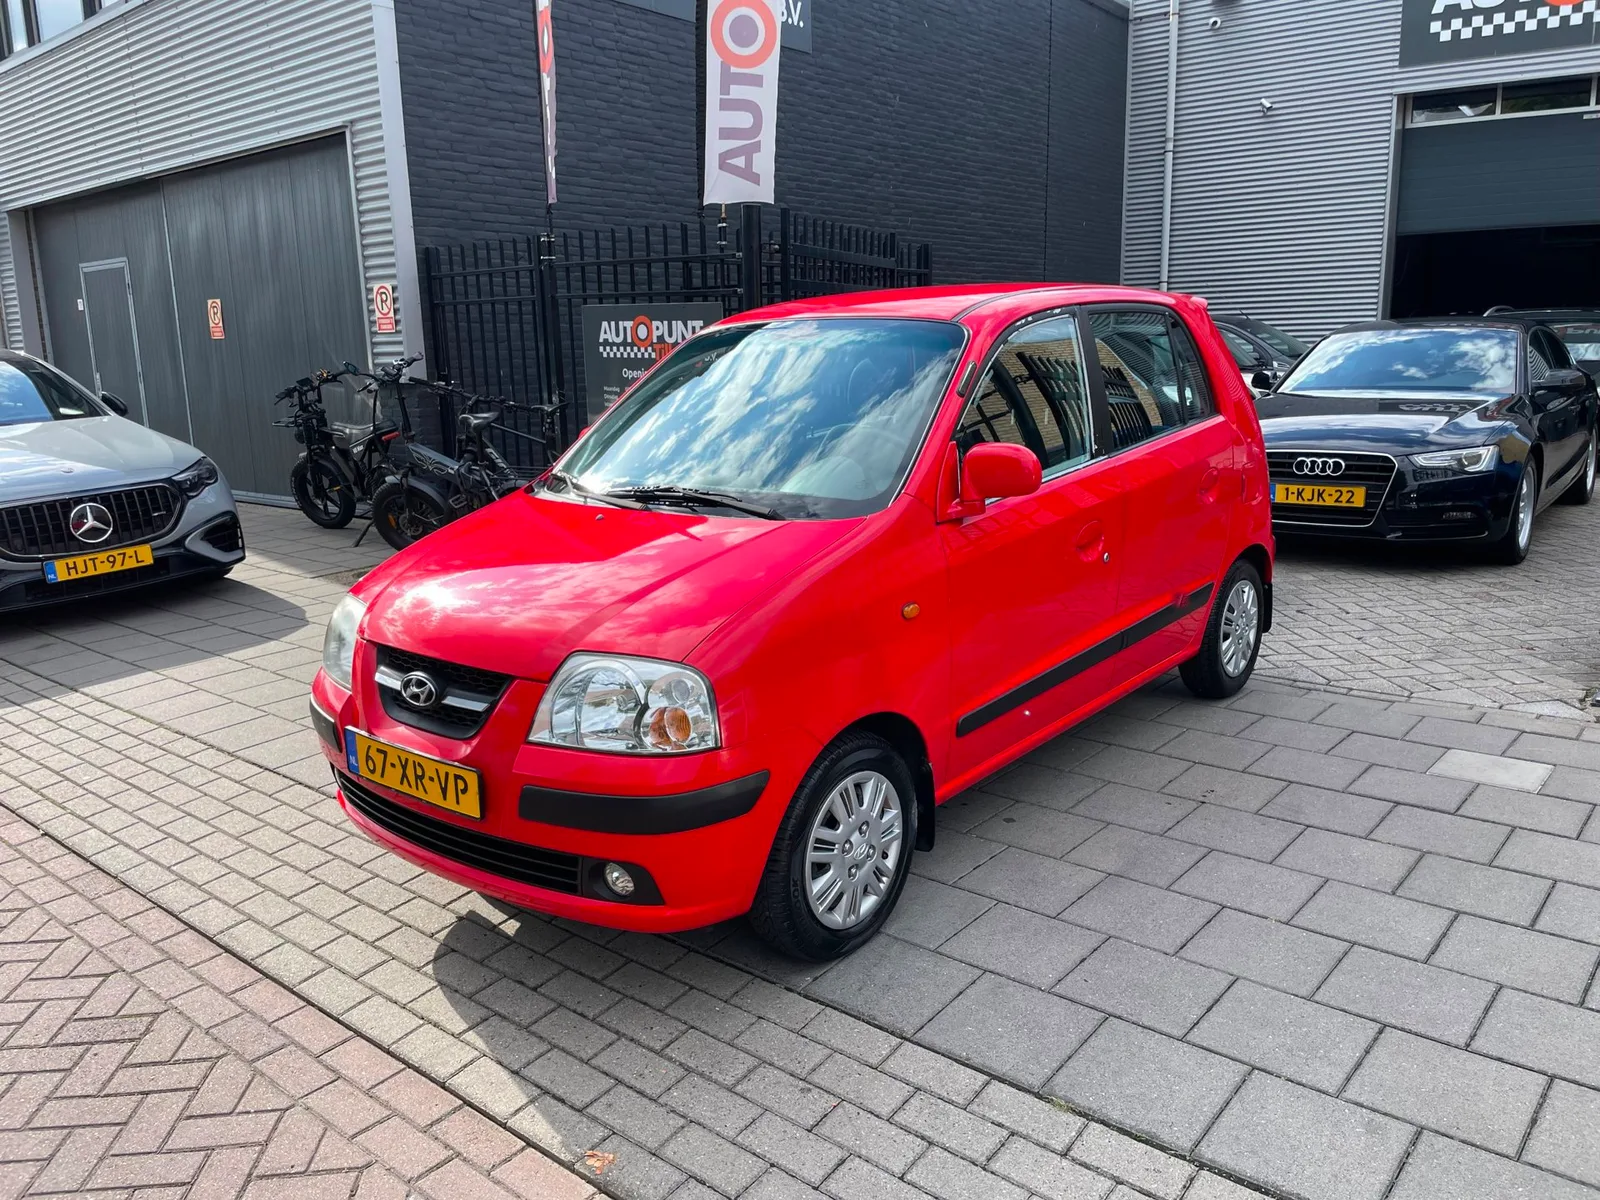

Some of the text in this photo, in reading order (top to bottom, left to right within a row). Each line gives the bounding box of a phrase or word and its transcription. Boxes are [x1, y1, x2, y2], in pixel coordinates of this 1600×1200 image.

[710, 0, 777, 187] AUTO
[599, 315, 704, 348] AUTOPUNT
[1284, 487, 1355, 504] 1-KJK-22
[65, 550, 145, 577] HJT-97-L
[349, 755, 358, 767] NL
[365, 745, 469, 805] 67-XR-VP
